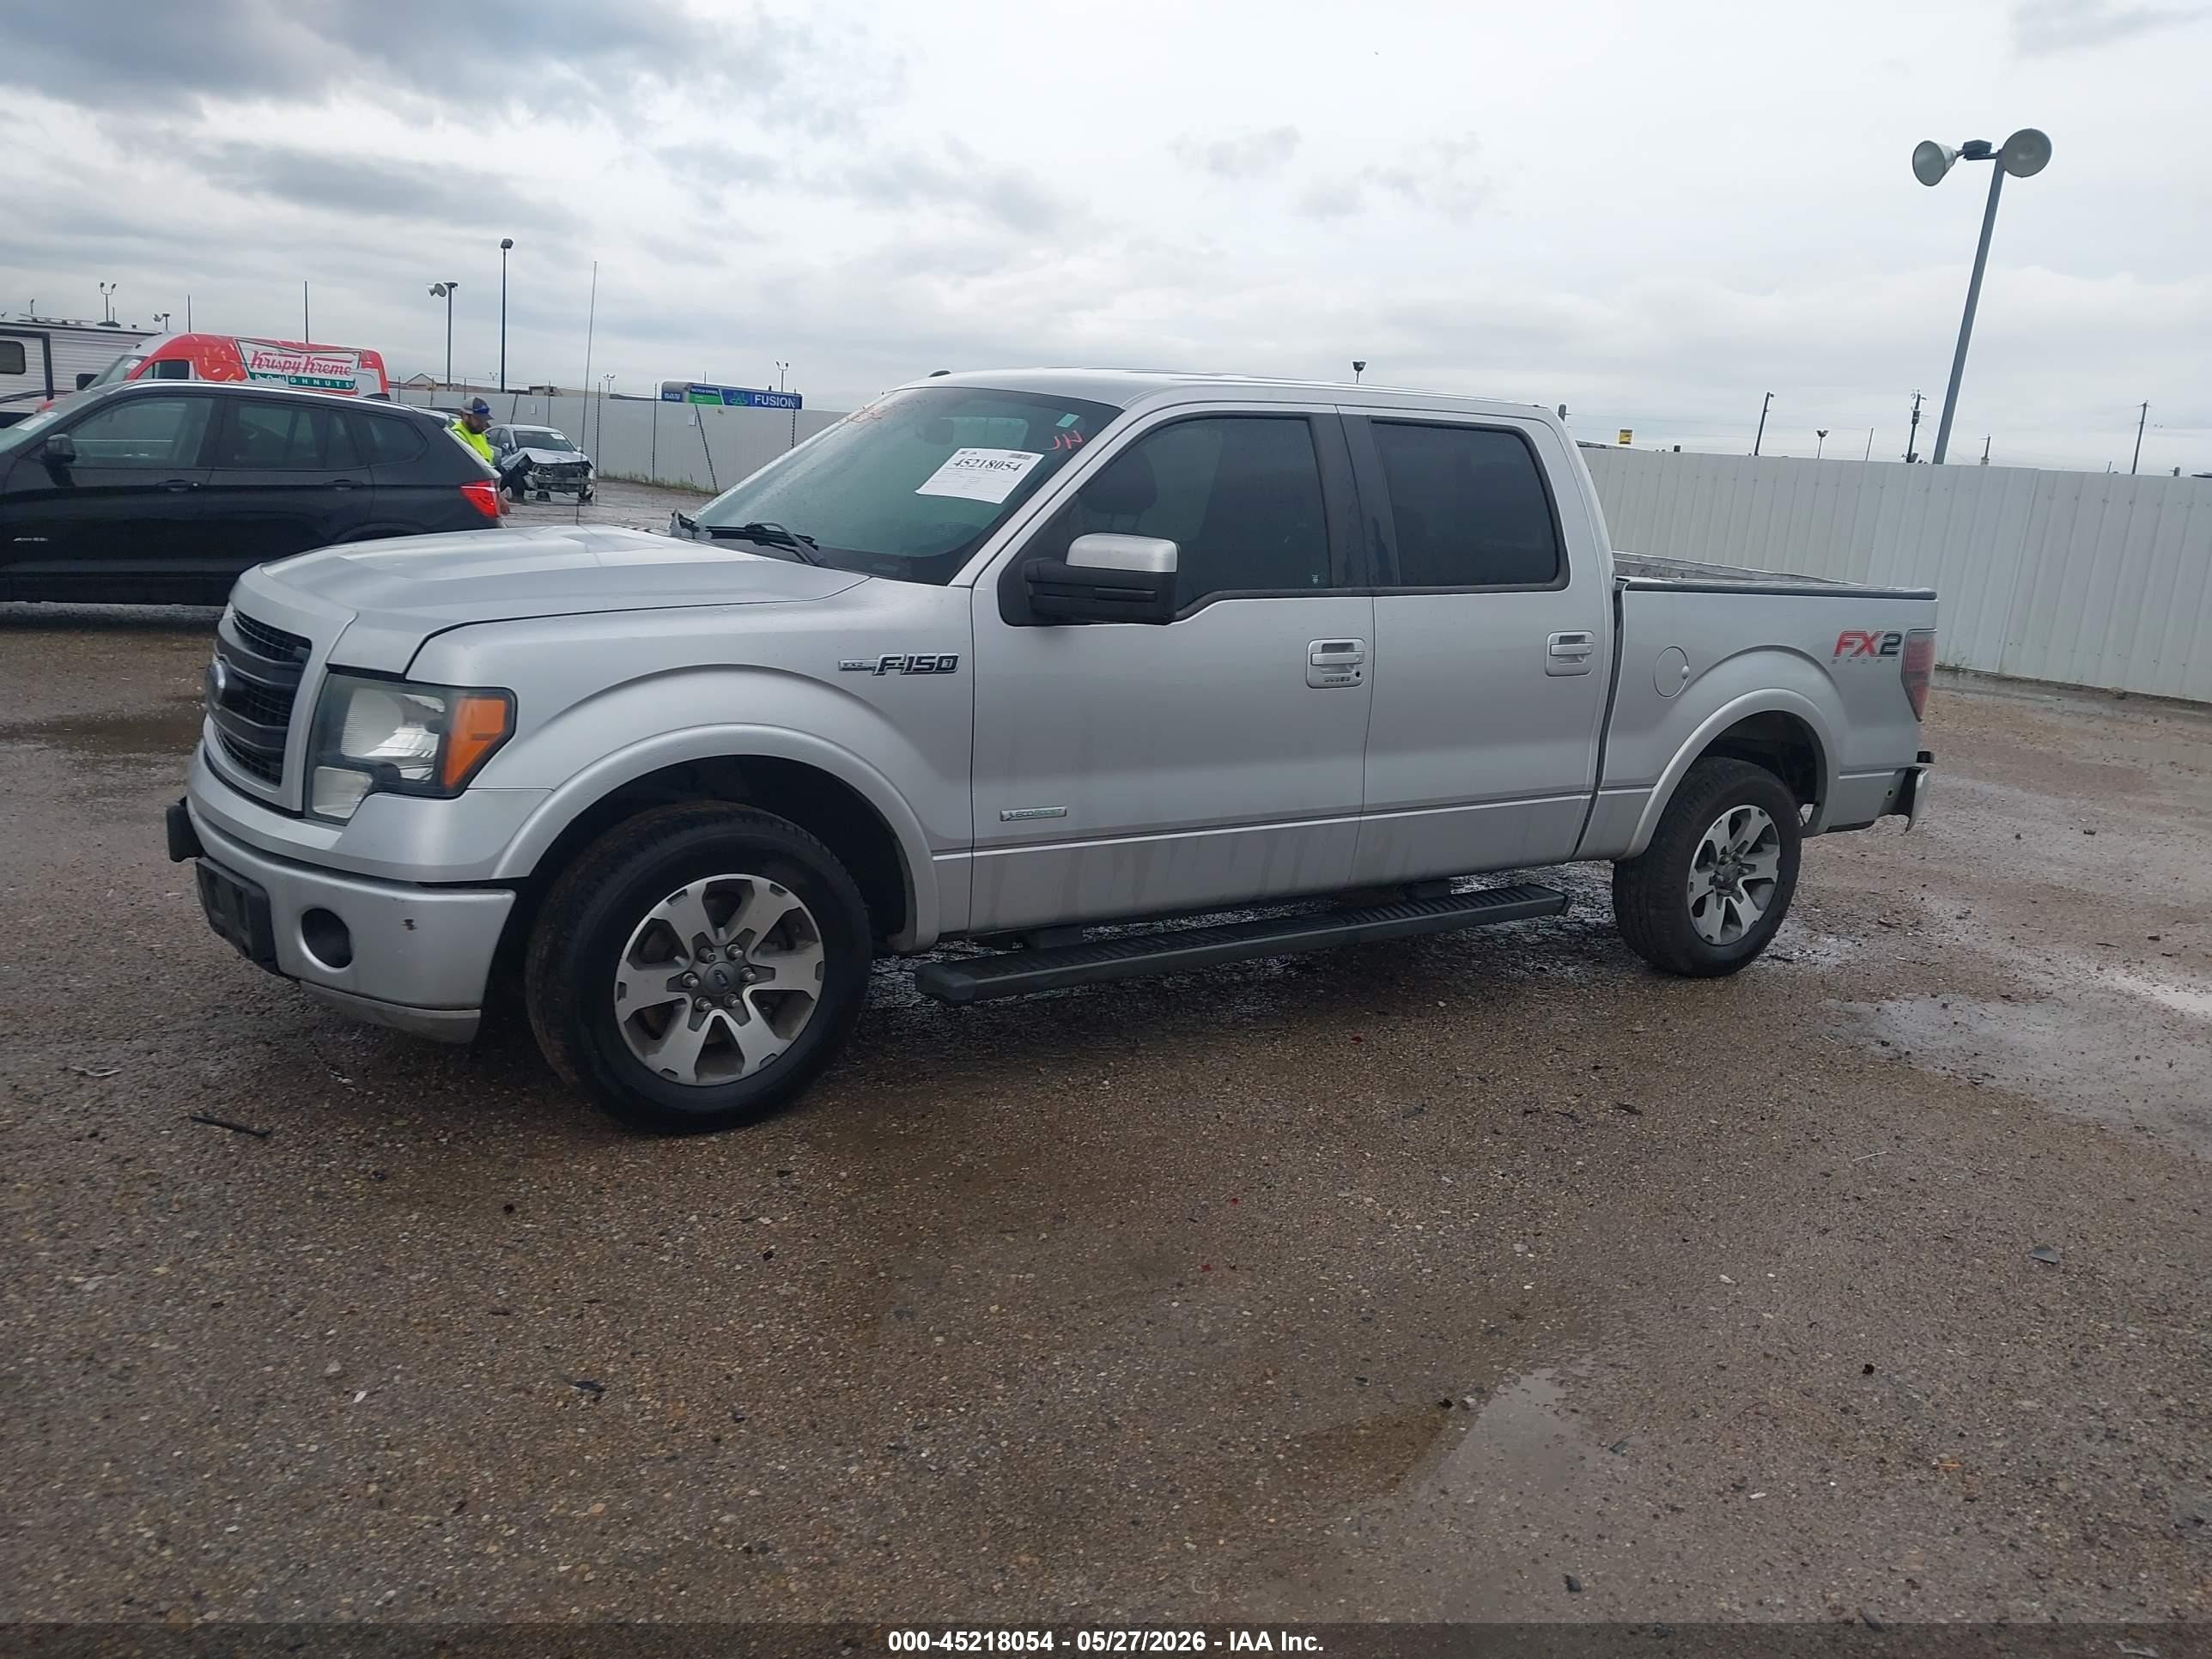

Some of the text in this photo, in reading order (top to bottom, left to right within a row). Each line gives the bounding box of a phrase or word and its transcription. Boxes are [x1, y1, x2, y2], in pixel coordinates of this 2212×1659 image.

[250, 350, 353, 376] Krispy Kreme
[754, 394, 796, 408] FUSION
[953, 458, 1024, 472] 45218054
[1833, 630, 1903, 658] FX2
[874, 653, 960, 675] F-150
